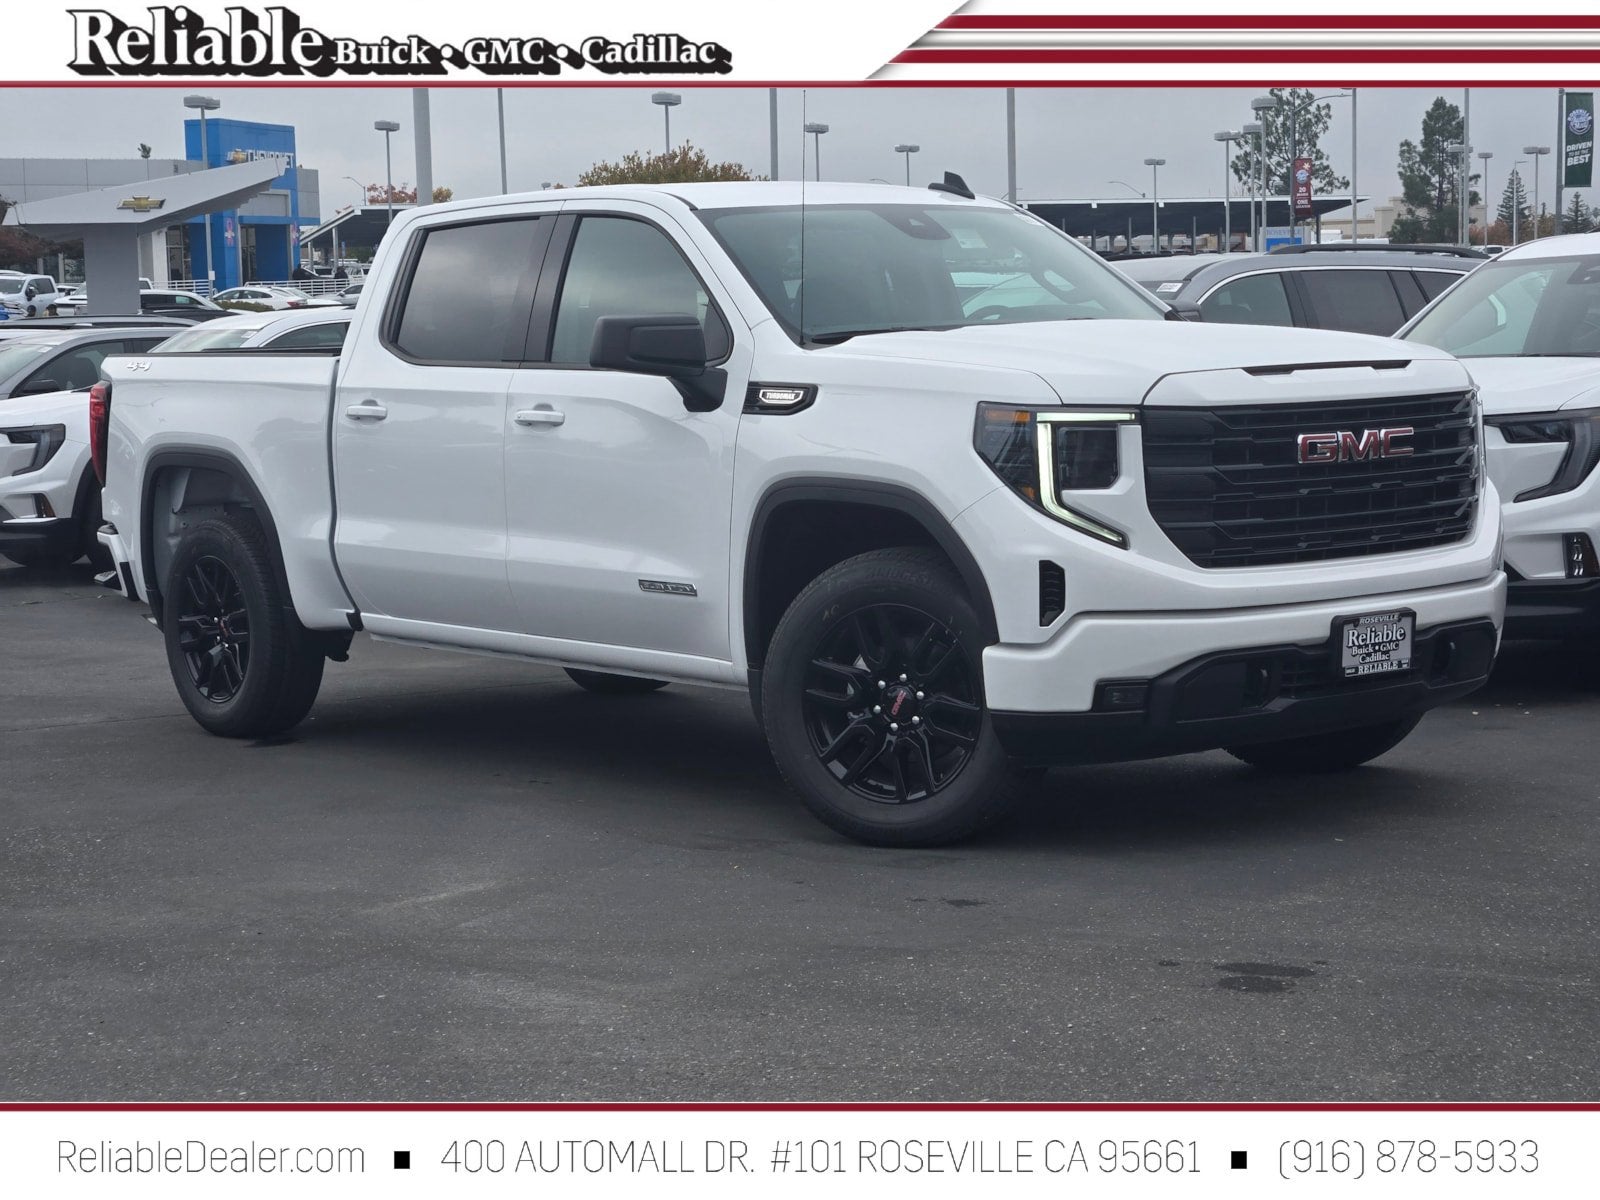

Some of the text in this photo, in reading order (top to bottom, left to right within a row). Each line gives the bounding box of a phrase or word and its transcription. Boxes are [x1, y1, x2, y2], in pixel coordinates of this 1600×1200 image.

[1566, 140, 1592, 152] DRIVEN
[1567, 154, 1591, 166] BEST
[1297, 426, 1415, 464] GMC
[1359, 613, 1399, 625] ROSEVILLE
[1347, 623, 1405, 647] Reliable
[1352, 641, 1399, 655] Buick GMC
[1359, 652, 1390, 663] Cadillac
[1358, 660, 1399, 675] RELIABLE
